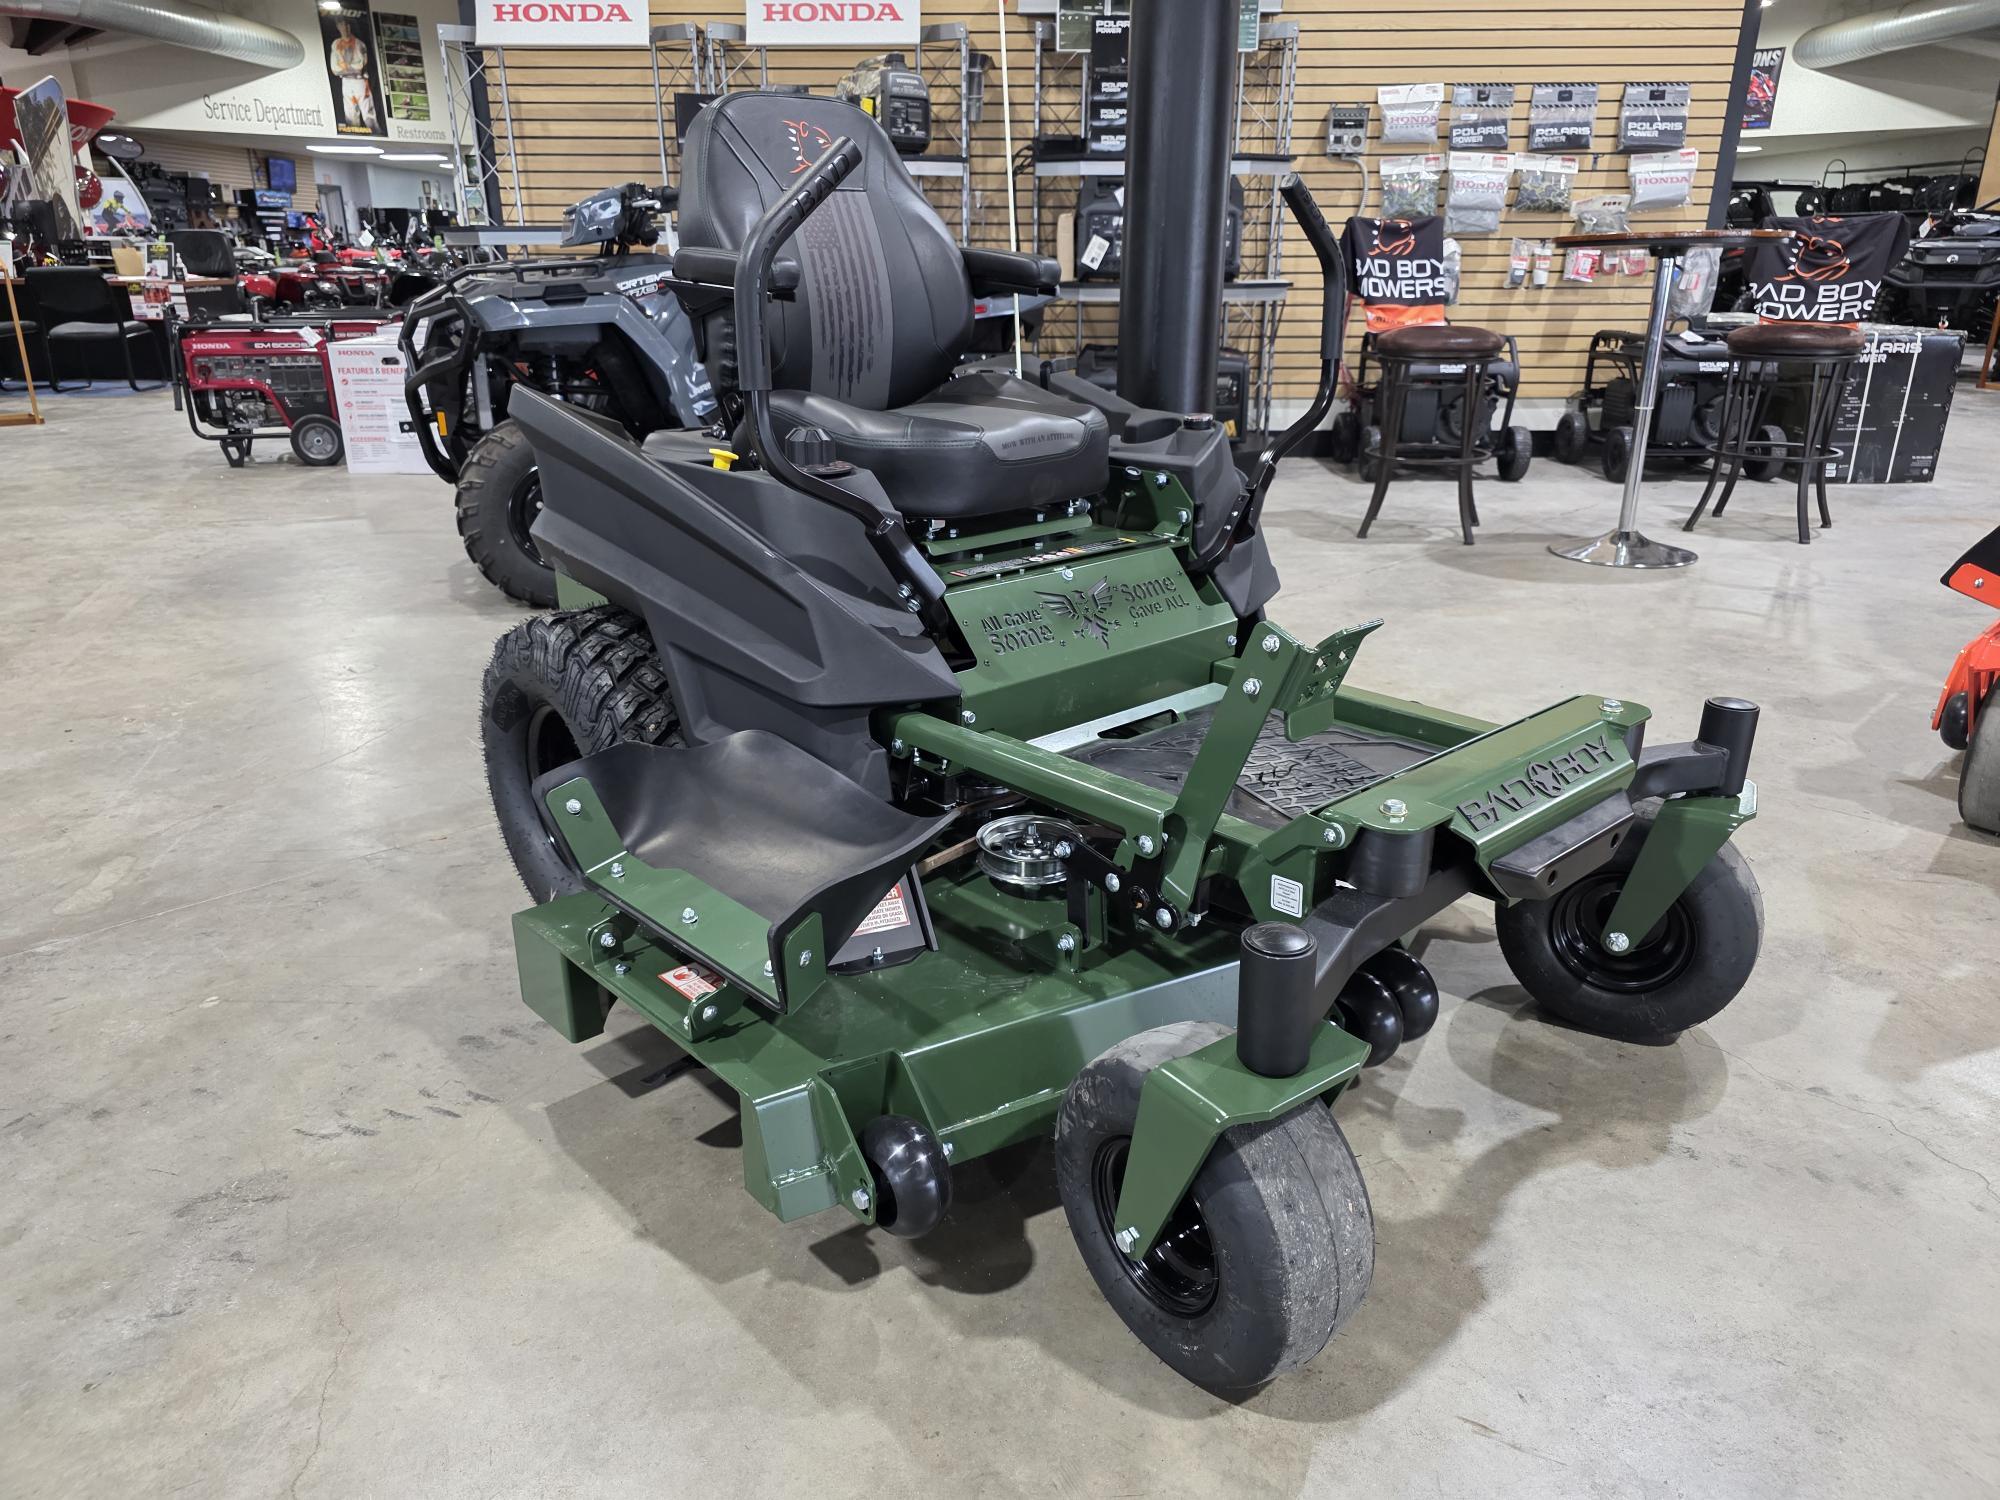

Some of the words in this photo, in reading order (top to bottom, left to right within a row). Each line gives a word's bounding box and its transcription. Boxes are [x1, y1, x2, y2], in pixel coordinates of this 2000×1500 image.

[493, 3, 632, 22] HONDA
[763, 3, 903, 22] HONDA
[203, 93, 252, 123] Service
[254, 98, 324, 130] Department
[1389, 114, 1438, 126] HONDA
[397, 126, 446, 141] Restrooms
[1453, 125, 1506, 137] POLARIS
[1535, 126, 1590, 137] POLARIS
[1627, 121, 1683, 131] POLARIS
[1453, 136, 1483, 144] POWER
[1455, 180, 1505, 190] HONDA
[1638, 176, 1690, 186] HONDA
[1396, 259, 1445, 278] BOY
[1817, 279, 1882, 303] BOY
[337, 367, 374, 375] FEATURES
[1119, 575, 1177, 603] Some
[1003, 607, 1044, 628] Gave
[1127, 602, 1164, 620] Gave
[987, 623, 1055, 655] Some
[1456, 776, 1537, 832] BAD
[1549, 734, 1616, 786] BOY
